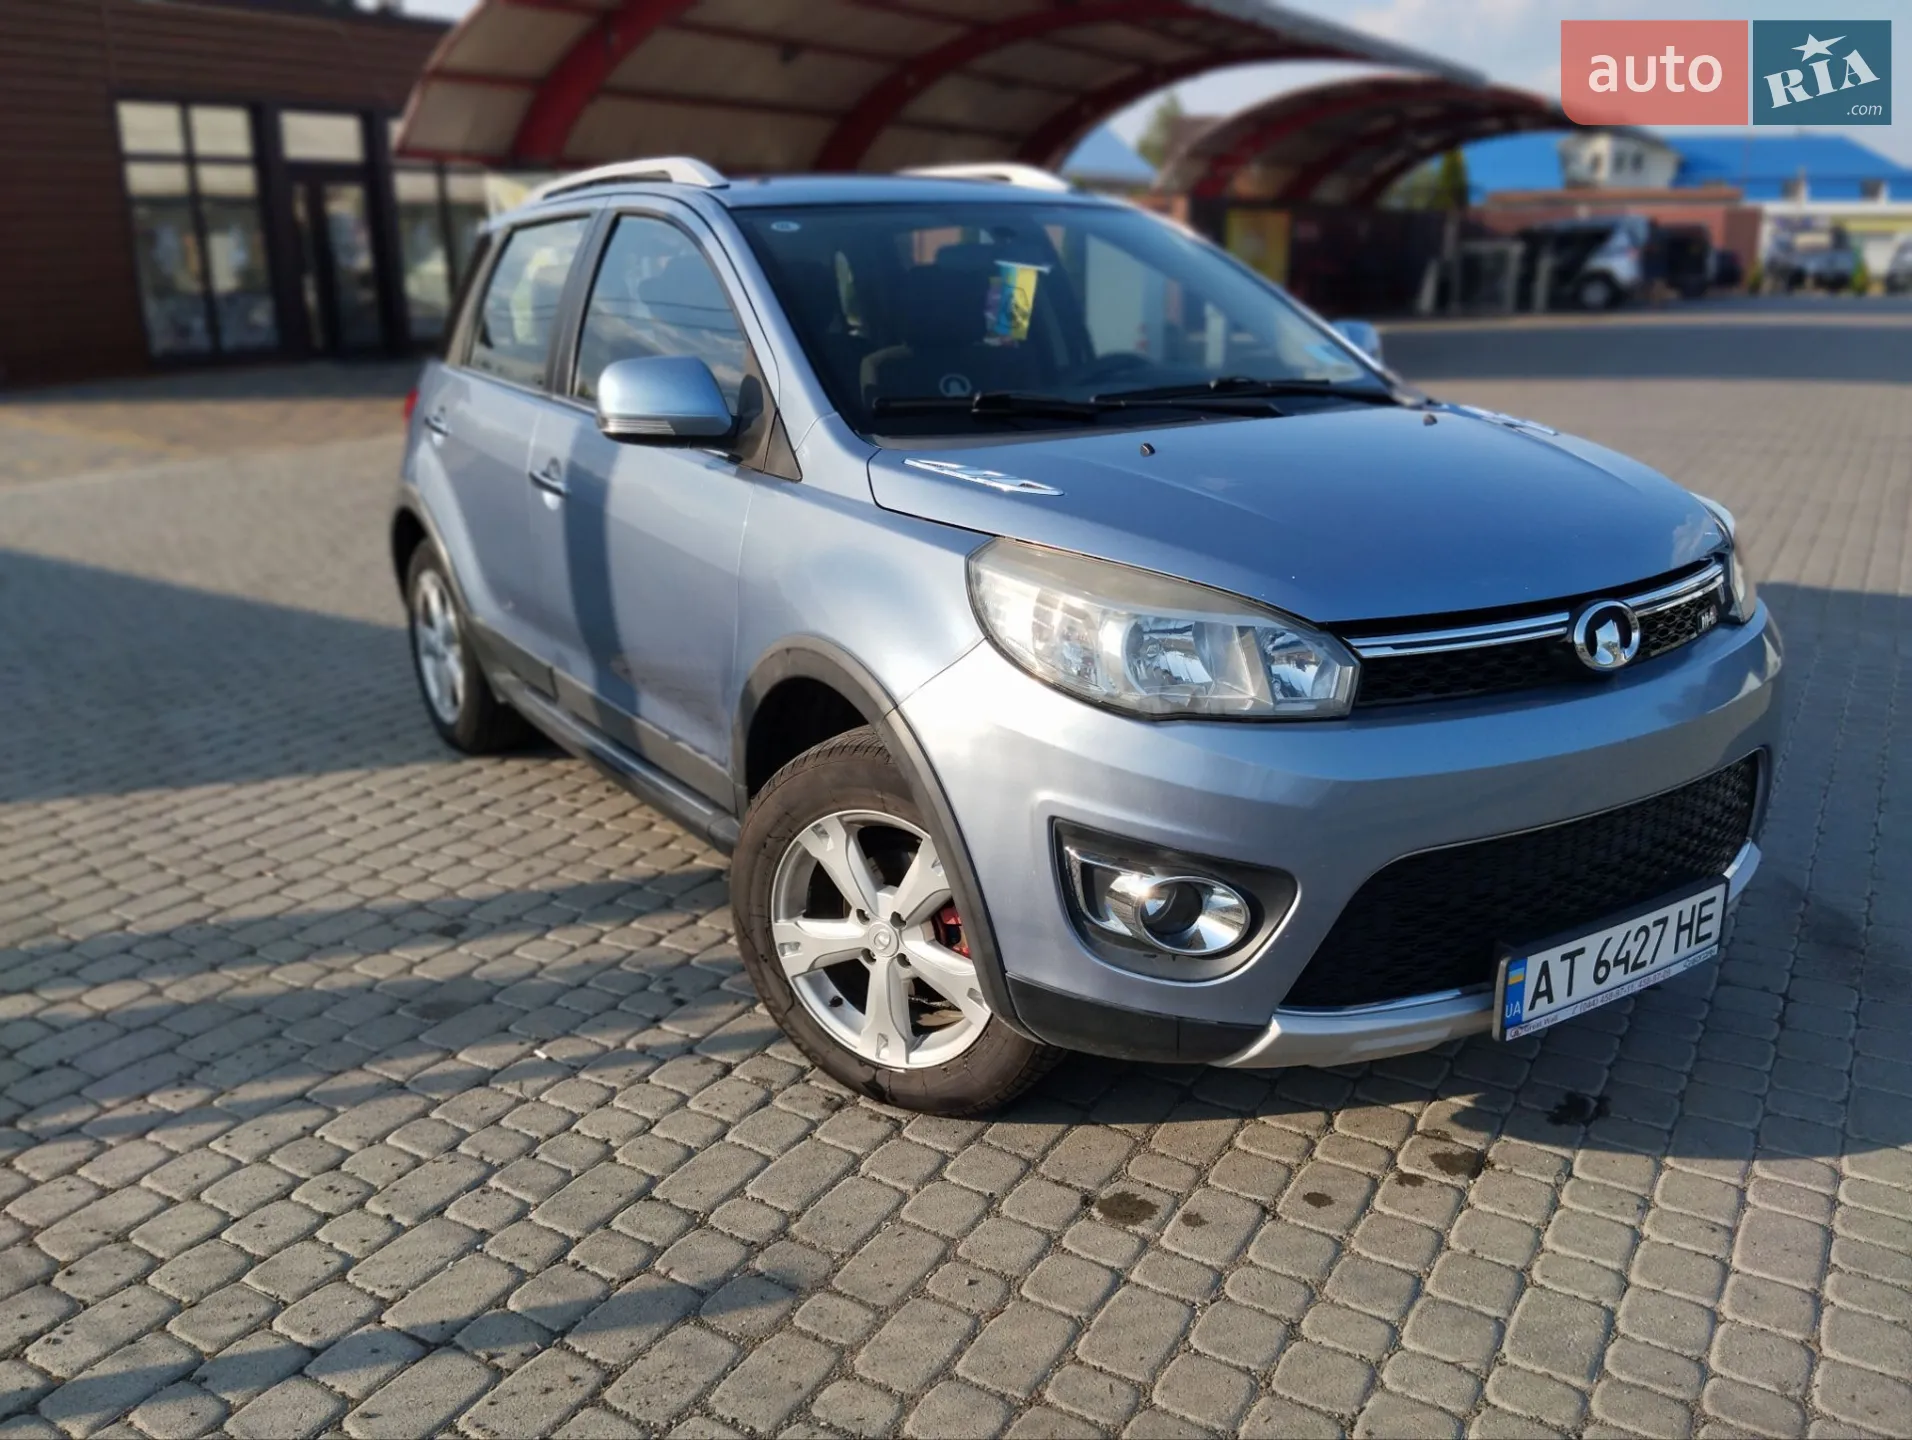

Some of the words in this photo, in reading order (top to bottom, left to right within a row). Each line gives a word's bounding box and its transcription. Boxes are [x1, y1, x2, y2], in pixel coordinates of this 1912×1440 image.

[1528, 947, 1586, 1011] AT
[1593, 915, 1669, 985] 6427
[1674, 896, 1717, 954] HE
[1505, 1001, 1521, 1018] UA
